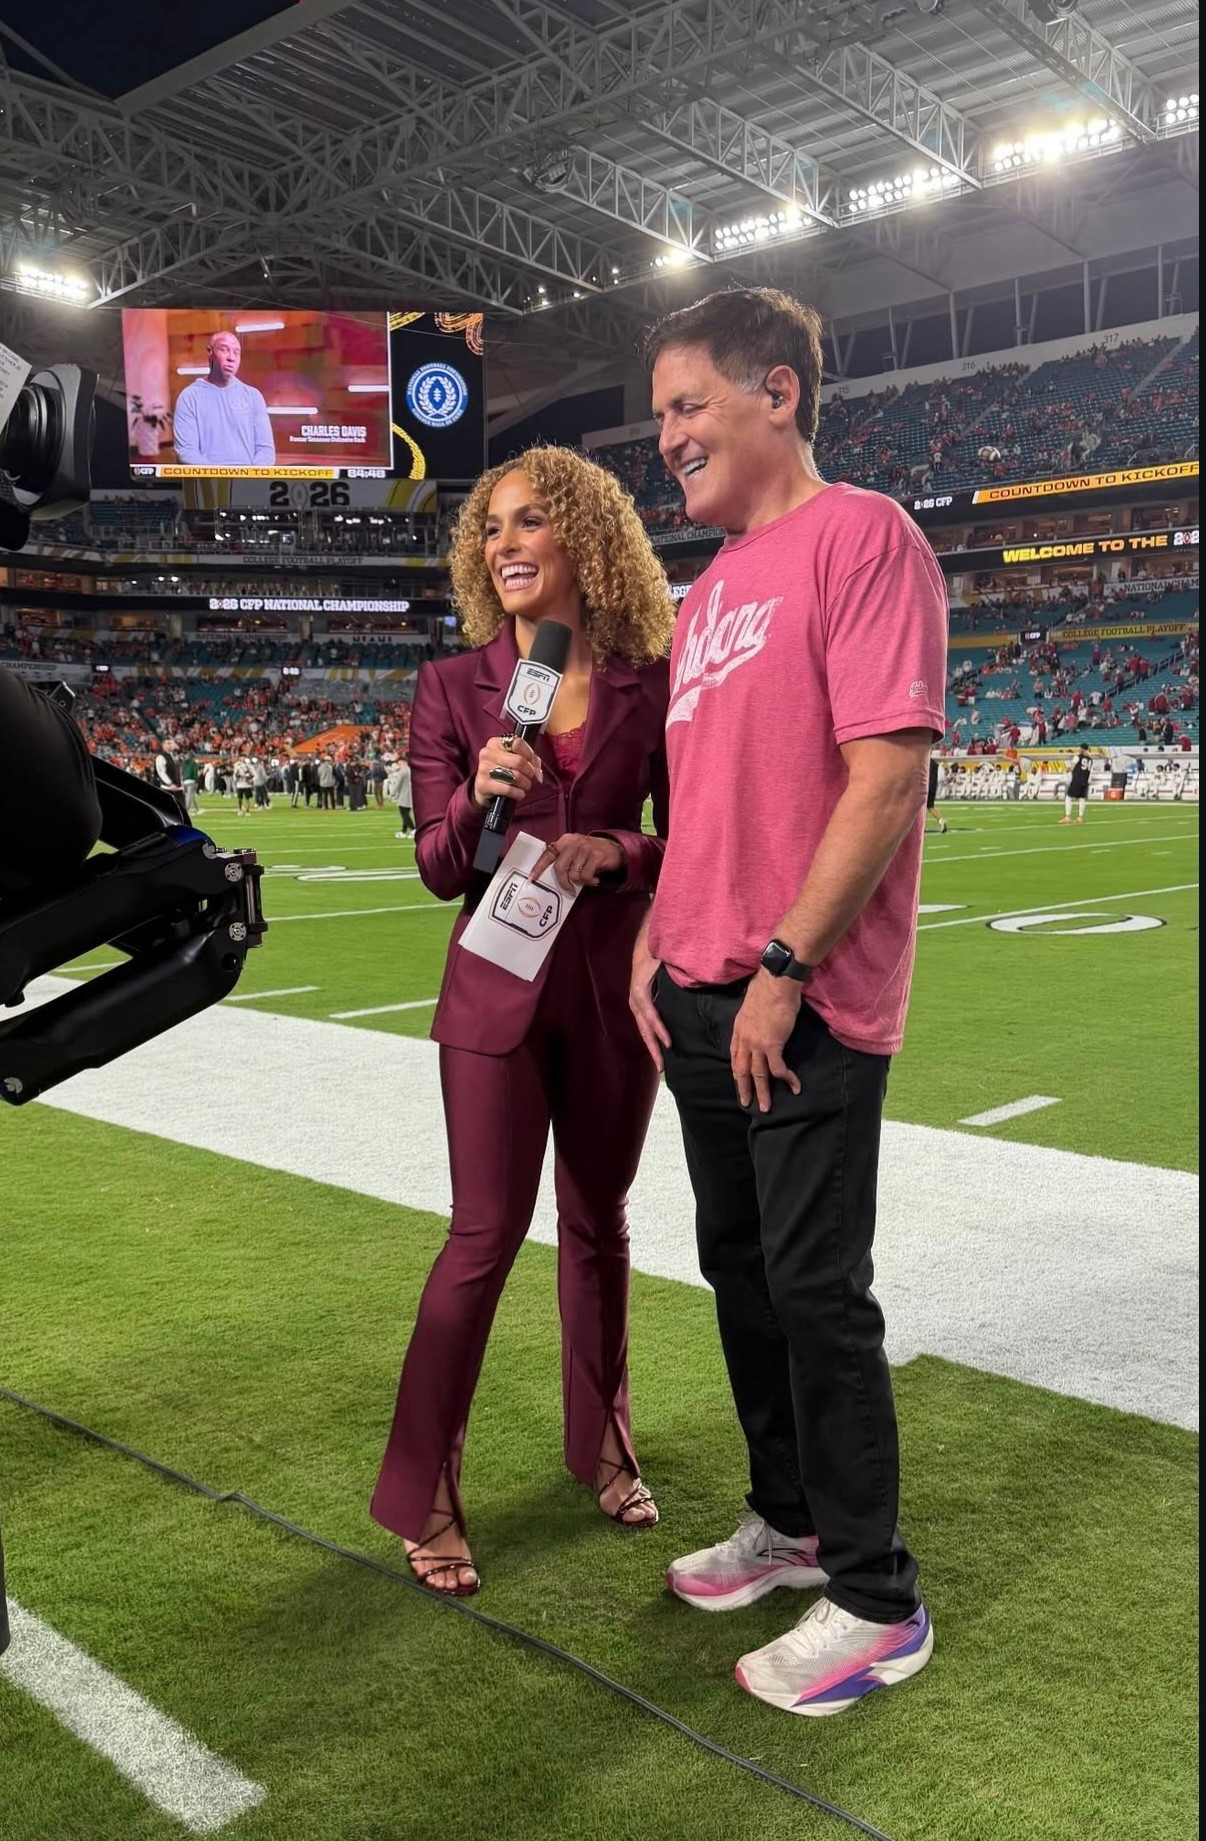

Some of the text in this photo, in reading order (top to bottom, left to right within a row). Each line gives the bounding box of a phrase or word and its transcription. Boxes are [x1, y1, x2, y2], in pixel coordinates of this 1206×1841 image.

[301, 425, 367, 438] CHARLES DAVIS
[163, 467, 334, 477] COUNTDOWN TO KICKOFF
[989, 463, 1199, 499] COUNTDOWN TO KICKOFF
[935, 496, 953, 507] CFP
[1003, 542, 1095, 564] WELCOME
[1099, 538, 1125, 552] TO
[1128, 535, 1169, 549] THE
[239, 598, 263, 611] CFP
[263, 598, 323, 611] NATIONAL
[323, 599, 410, 612] CHAMPIONSHIP
[1062, 623, 1186, 639] COLLEGE FOOTBALL PLAYOFF
[526, 668, 551, 682] ESPN
[517, 704, 537, 716] CFP
[500, 882, 519, 911] ESPN
[538, 904, 554, 928] CFP
